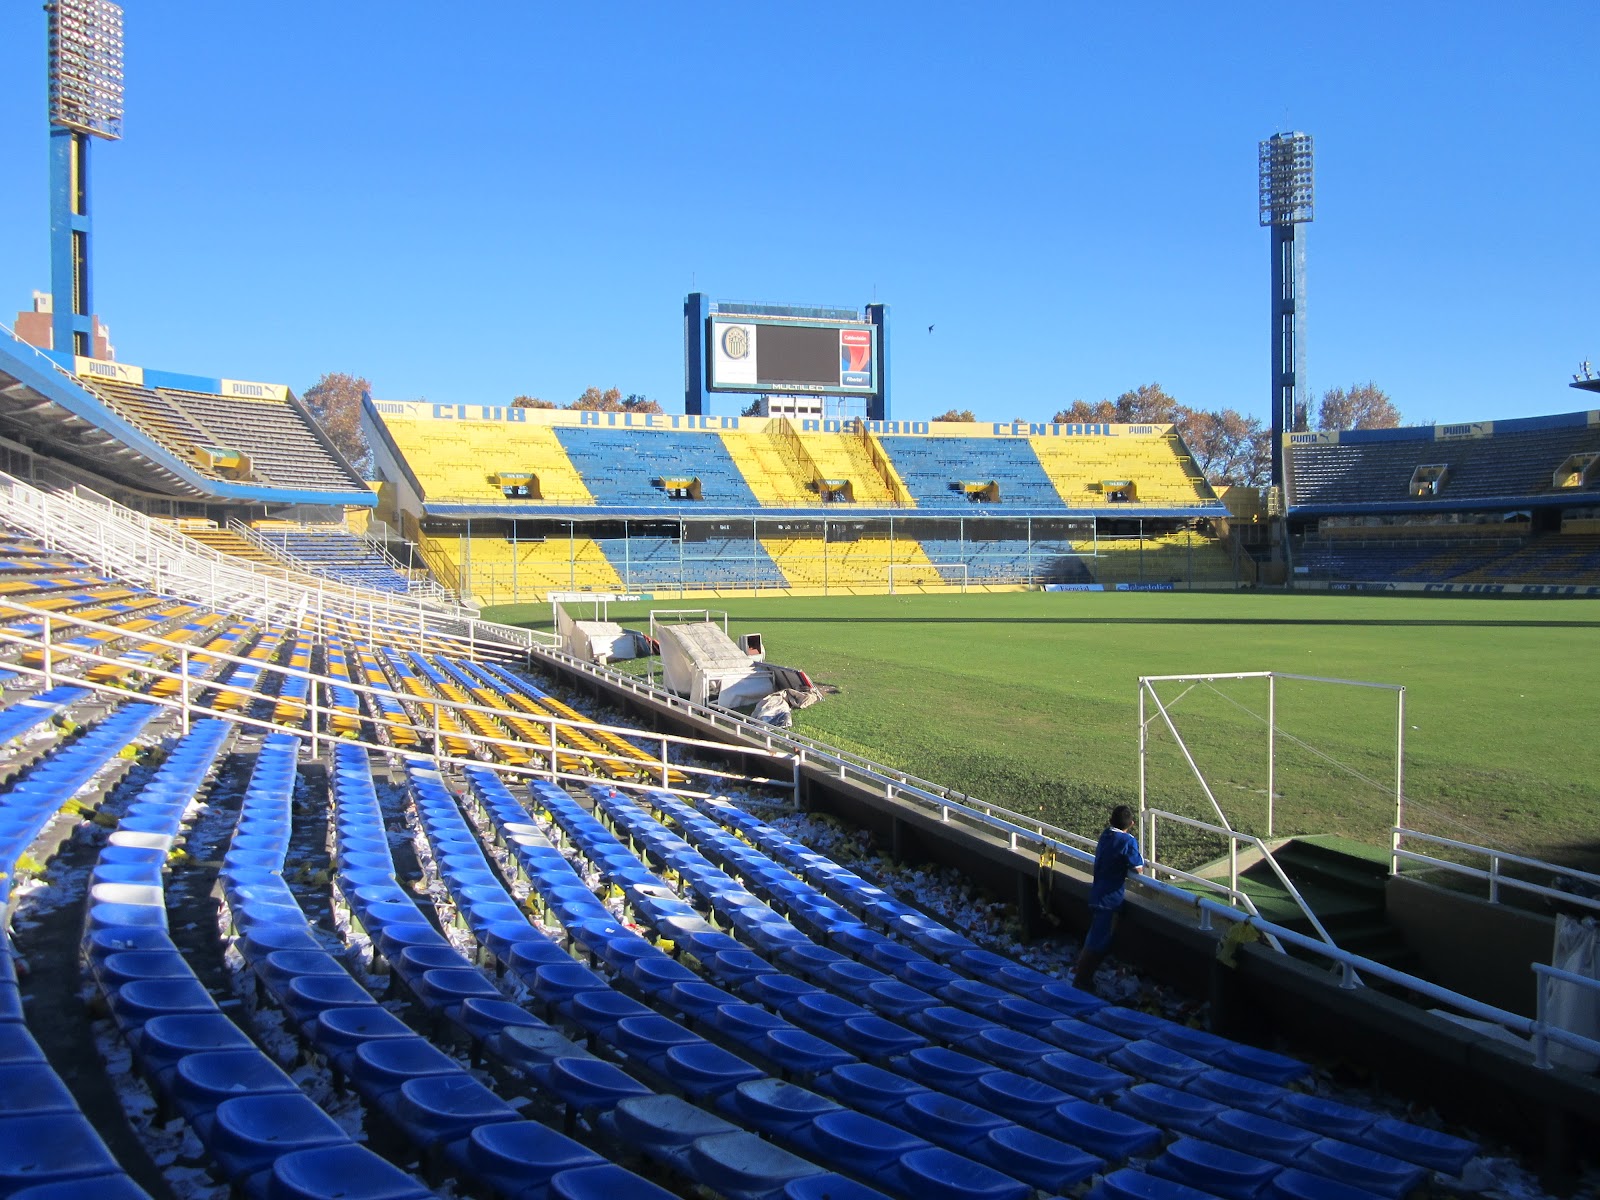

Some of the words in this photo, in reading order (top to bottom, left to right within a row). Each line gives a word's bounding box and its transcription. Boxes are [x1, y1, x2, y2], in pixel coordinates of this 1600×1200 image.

[89, 360, 117, 377] PUMA
[233, 383, 263, 396] PUMA
[772, 383, 825, 391] MULTILED
[375, 402, 404, 414] PUMA
[432, 403, 526, 422] CLUB
[580, 410, 739, 429] ATLETICO
[802, 418, 929, 435] ROSARIO
[993, 422, 1120, 437] CENTRAL
[1128, 425, 1153, 435] PUMA
[1442, 424, 1471, 435] PUMA
[1290, 433, 1317, 443] PUMA
